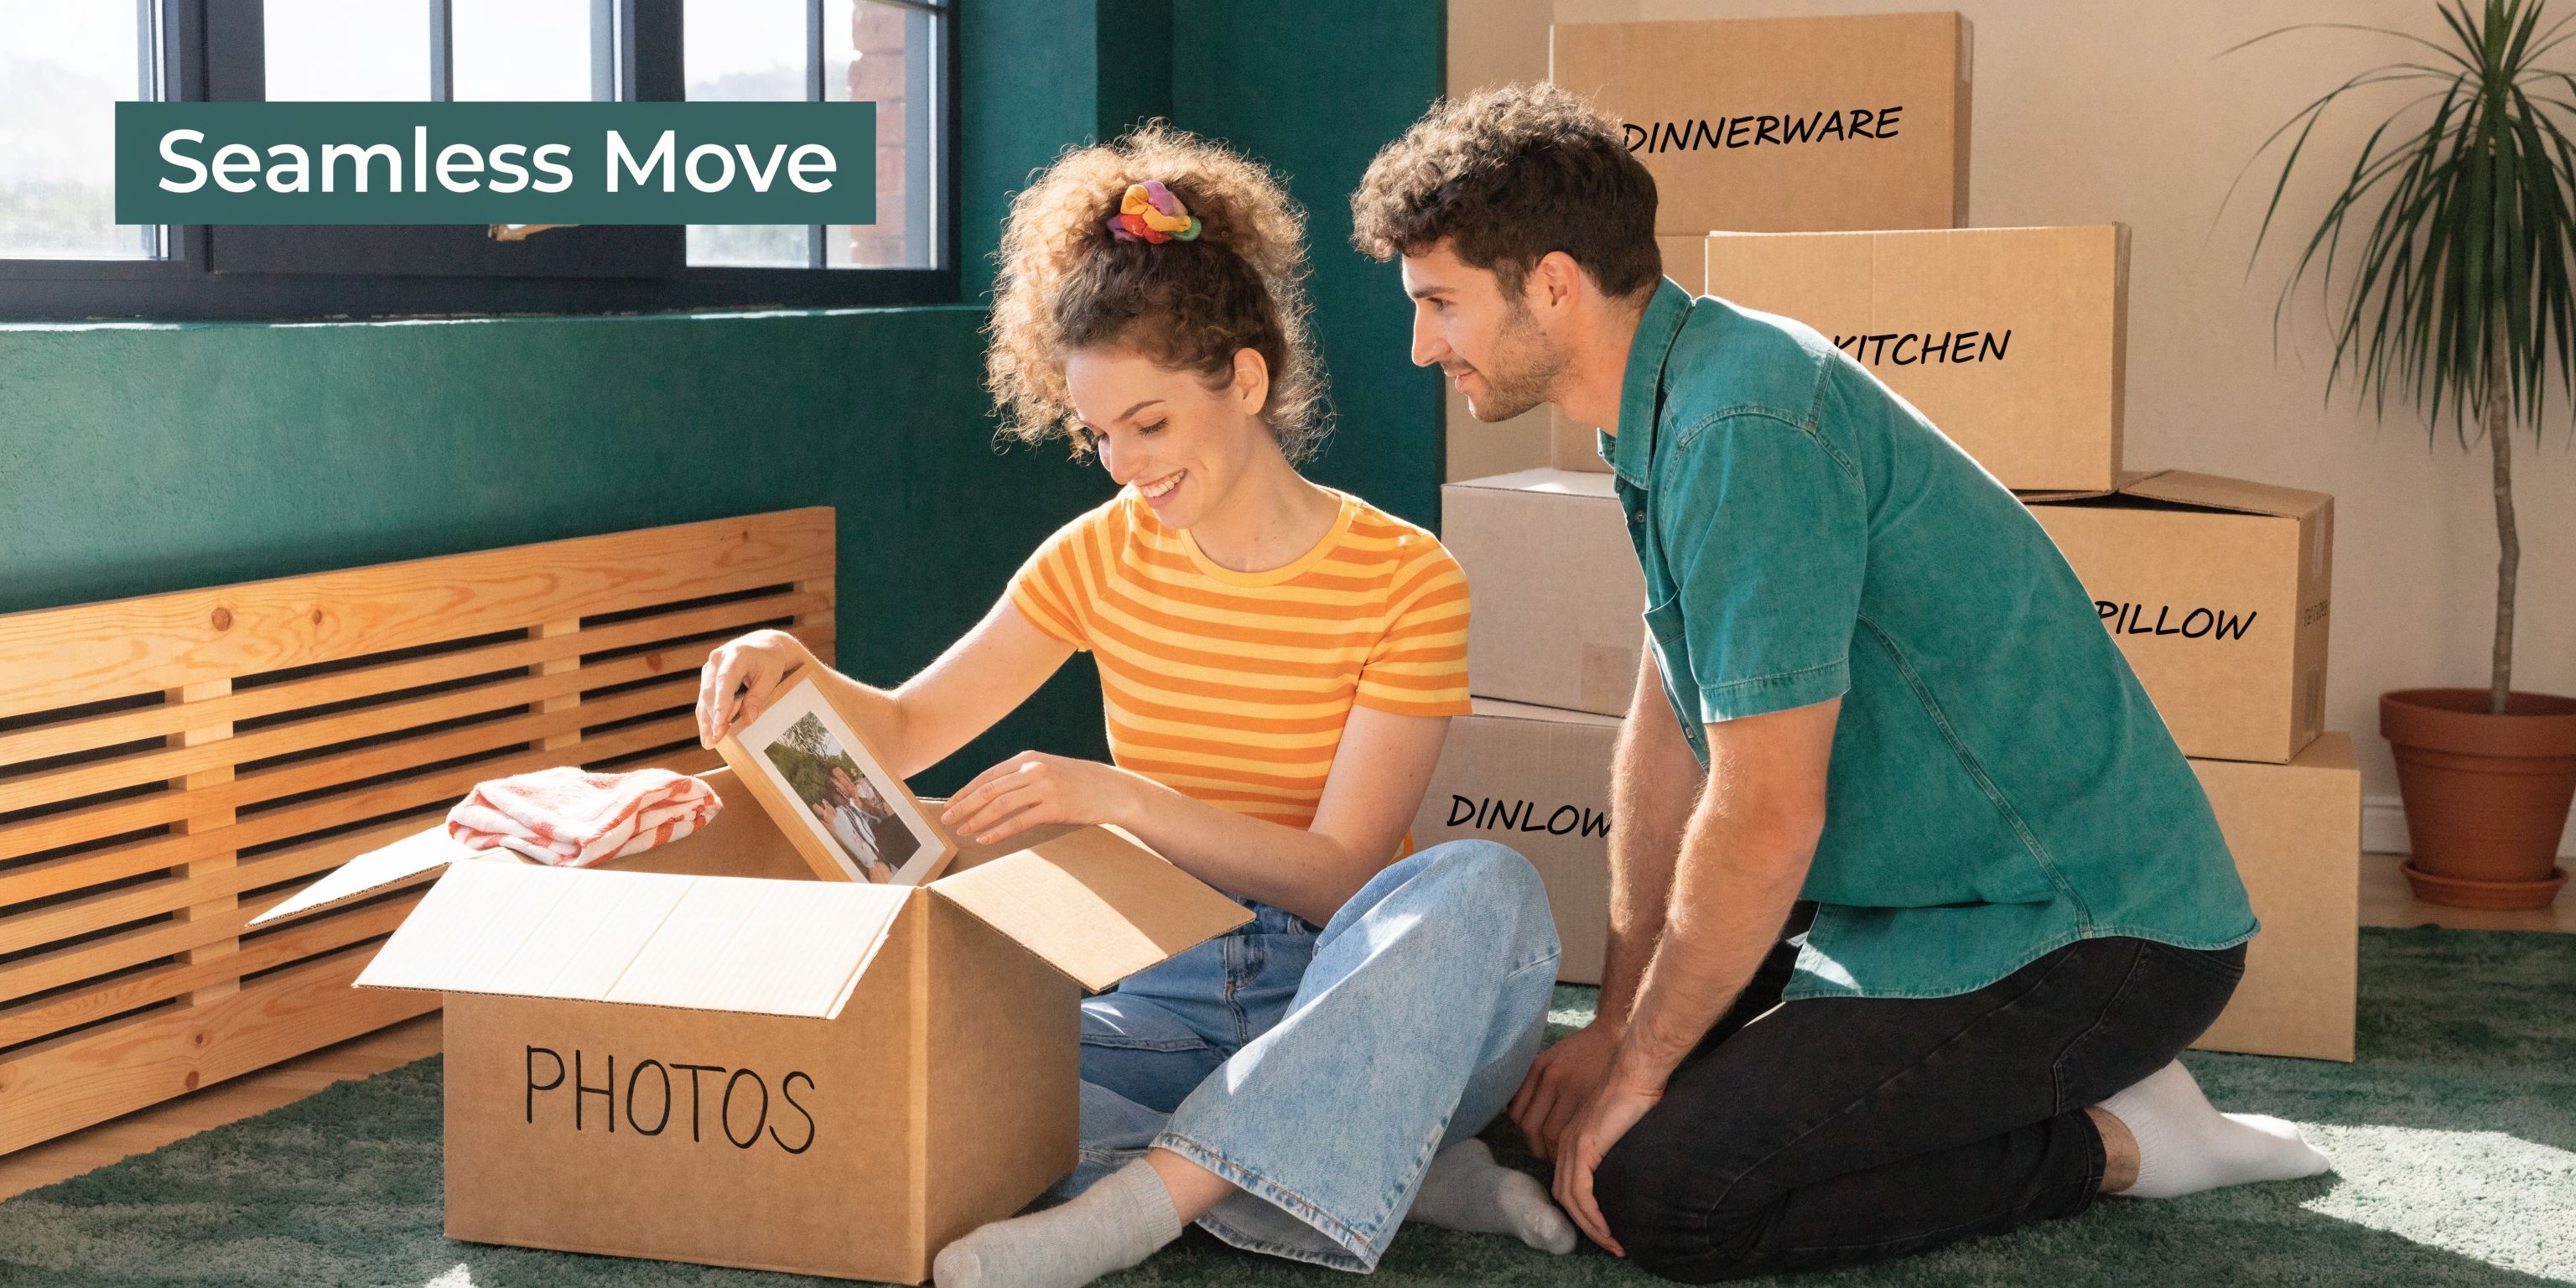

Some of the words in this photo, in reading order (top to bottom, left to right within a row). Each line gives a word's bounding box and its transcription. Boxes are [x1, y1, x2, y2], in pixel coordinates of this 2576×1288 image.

[1623, 106, 1903, 153] DINNERWARE
[2095, 600, 2257, 641] PILLOW
[1446, 794, 1612, 839] DINLOW
[526, 1045, 815, 1155] PHOTOS
